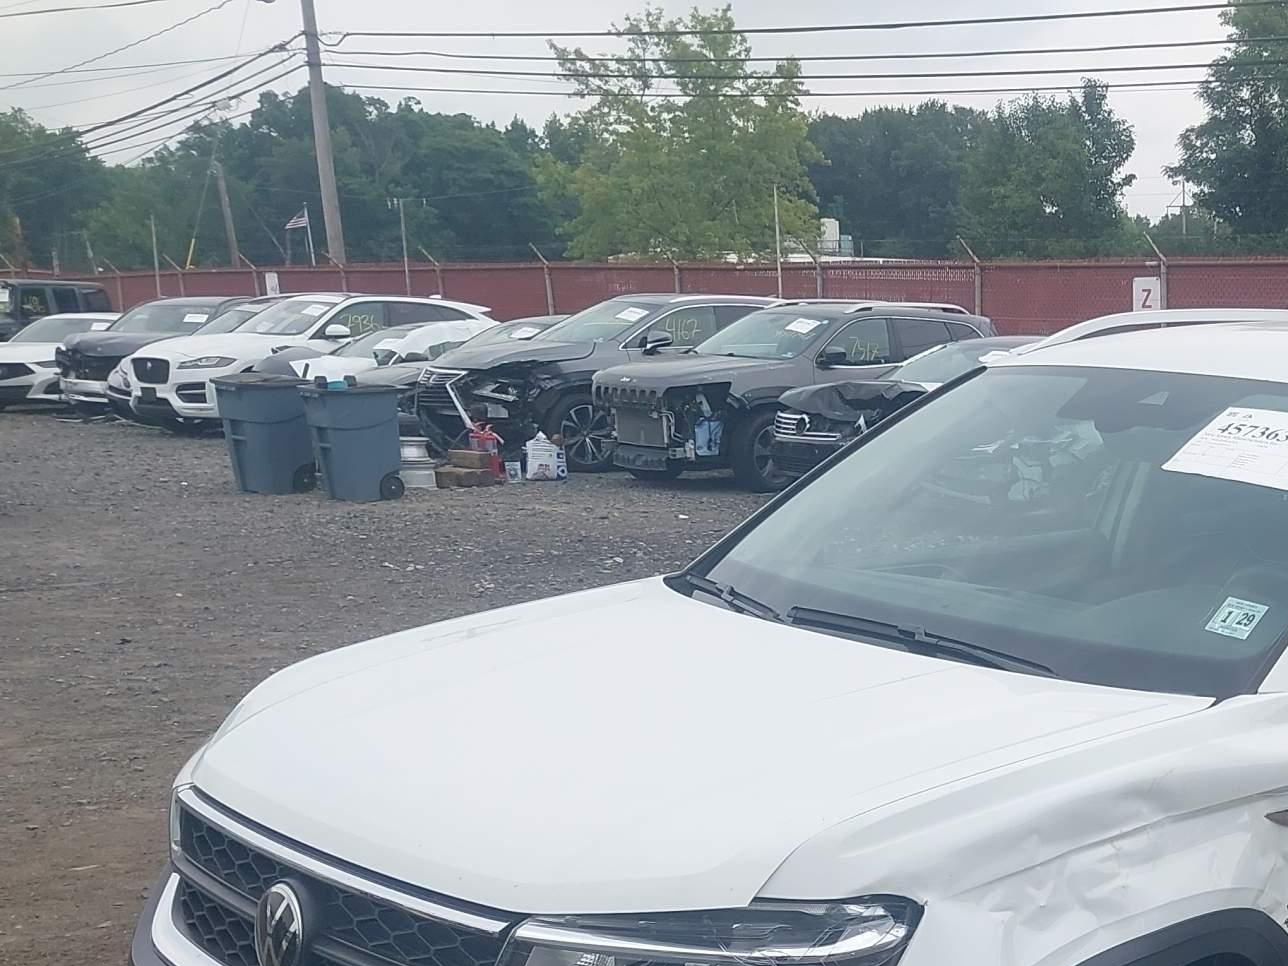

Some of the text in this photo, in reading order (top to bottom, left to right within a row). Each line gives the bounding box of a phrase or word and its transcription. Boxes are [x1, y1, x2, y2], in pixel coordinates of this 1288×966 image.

[1141, 288, 1153, 309] Z
[1221, 610, 1256, 627] 1 29
